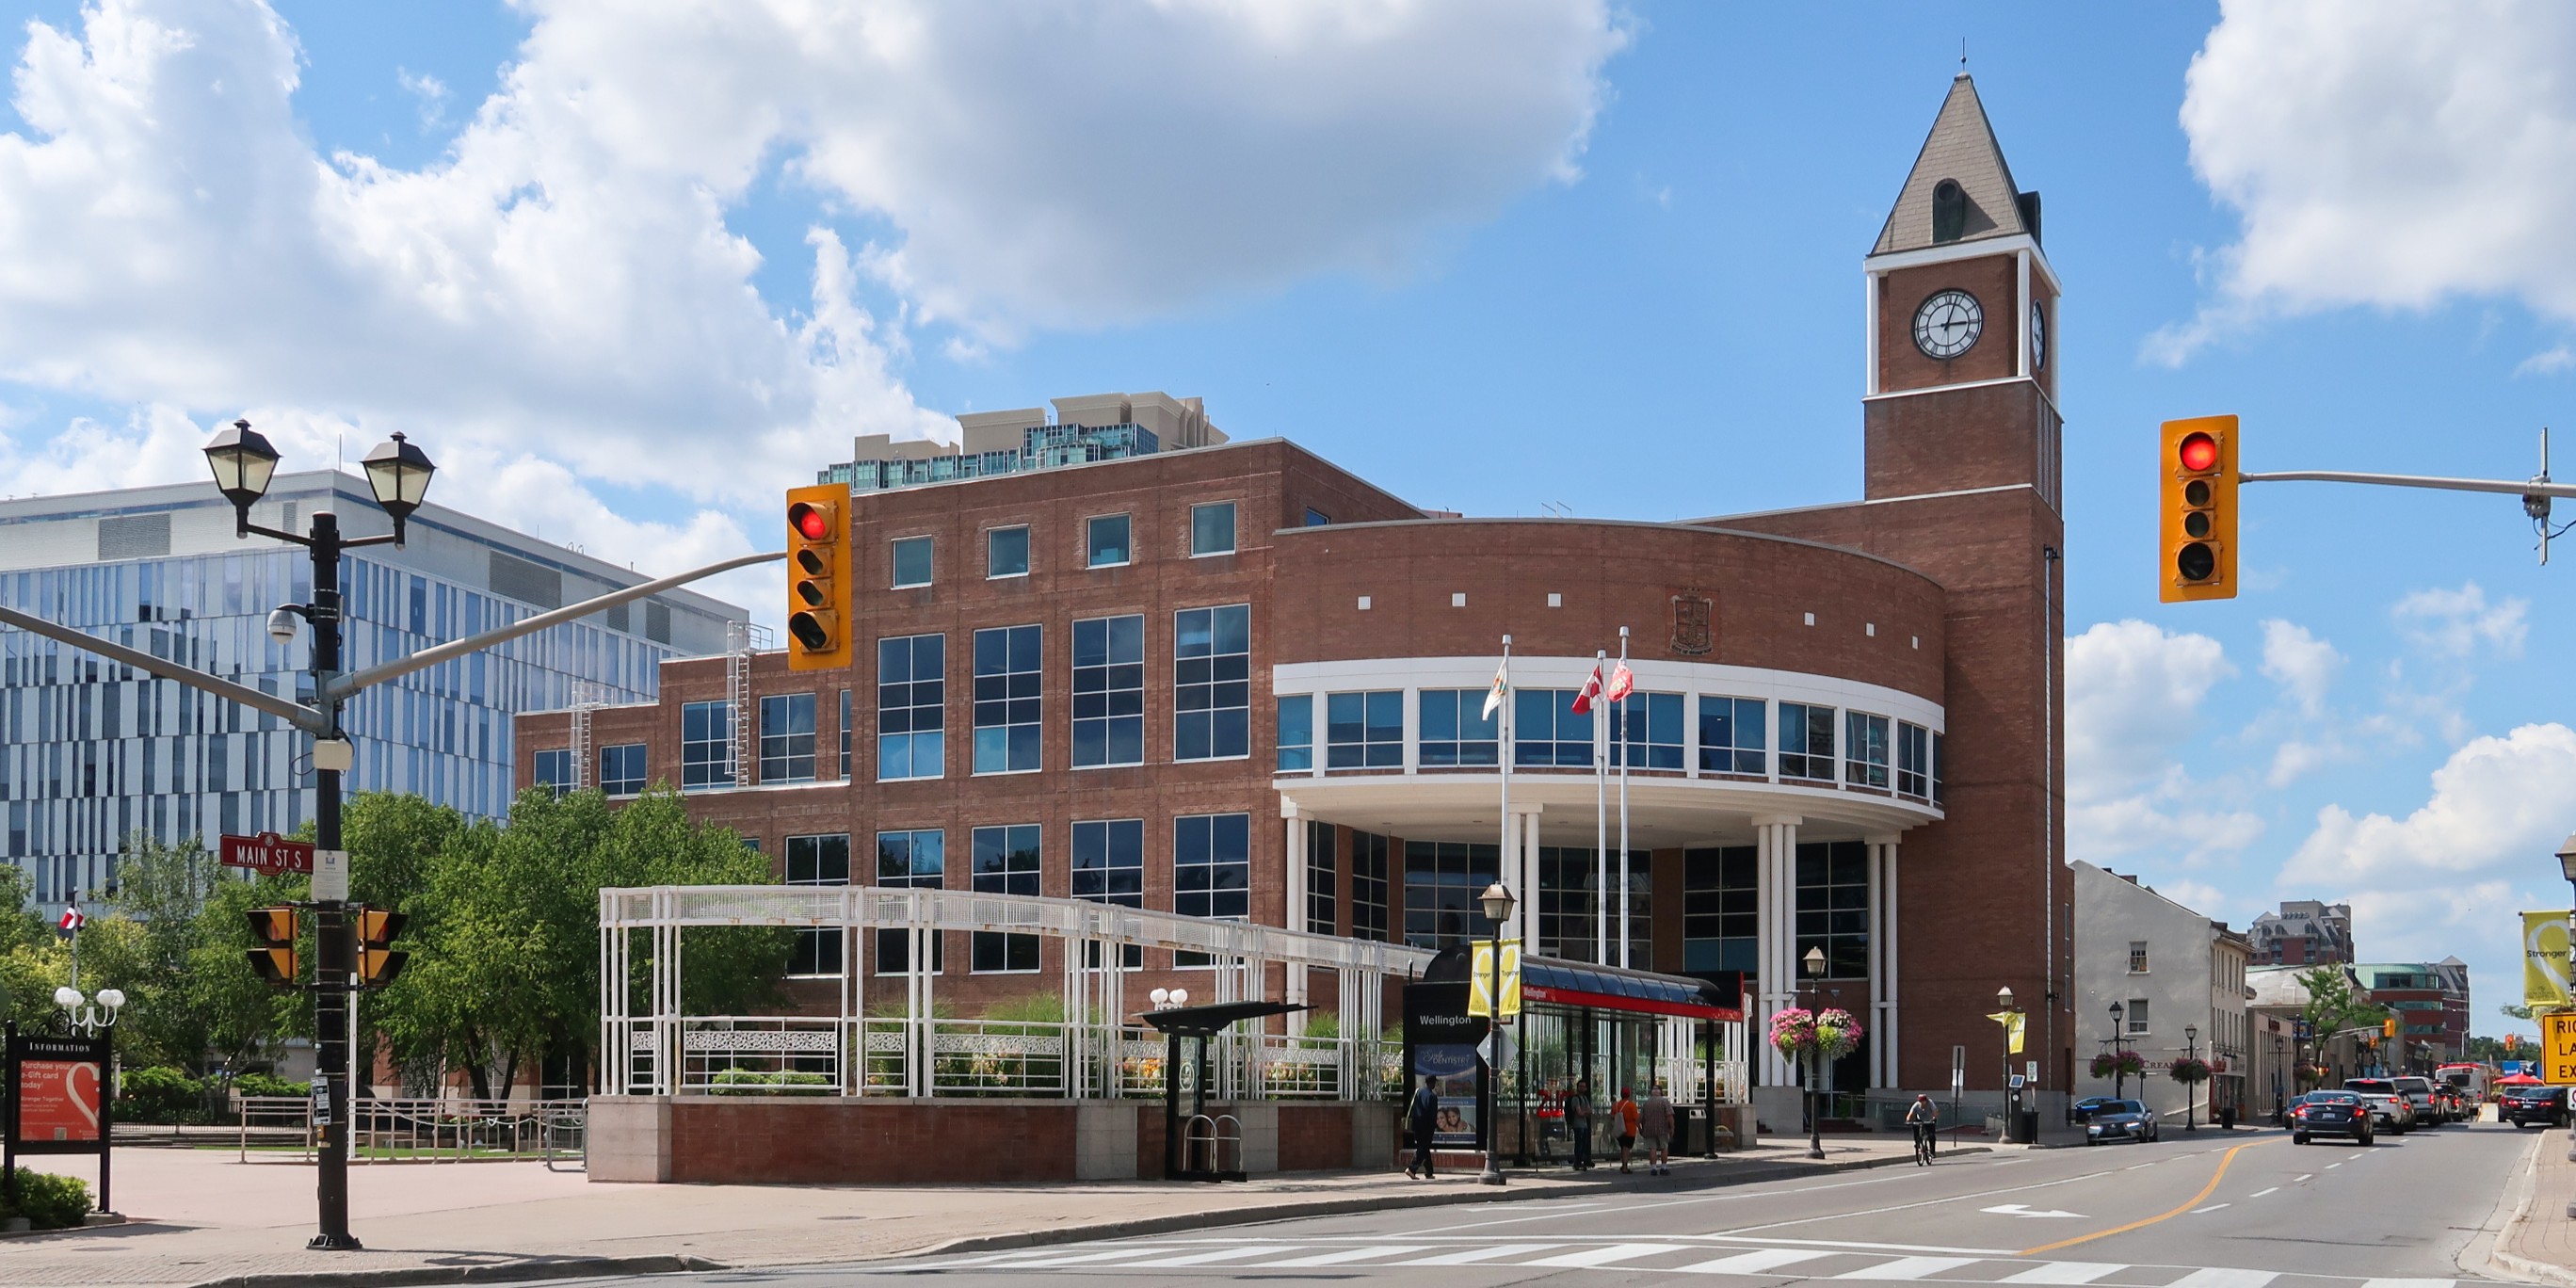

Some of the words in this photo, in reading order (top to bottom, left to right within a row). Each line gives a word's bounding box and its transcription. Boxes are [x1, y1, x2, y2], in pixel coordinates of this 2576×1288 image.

[236, 845, 268, 865] MAIN
[275, 848, 289, 867] ST
[295, 850, 301, 868] S
[2526, 950, 2567, 958] Stronger
[1523, 987, 1547, 999] Wellington
[1419, 1015, 1472, 1026] Wellington
[29, 1041, 90, 1052] INFORMATION
